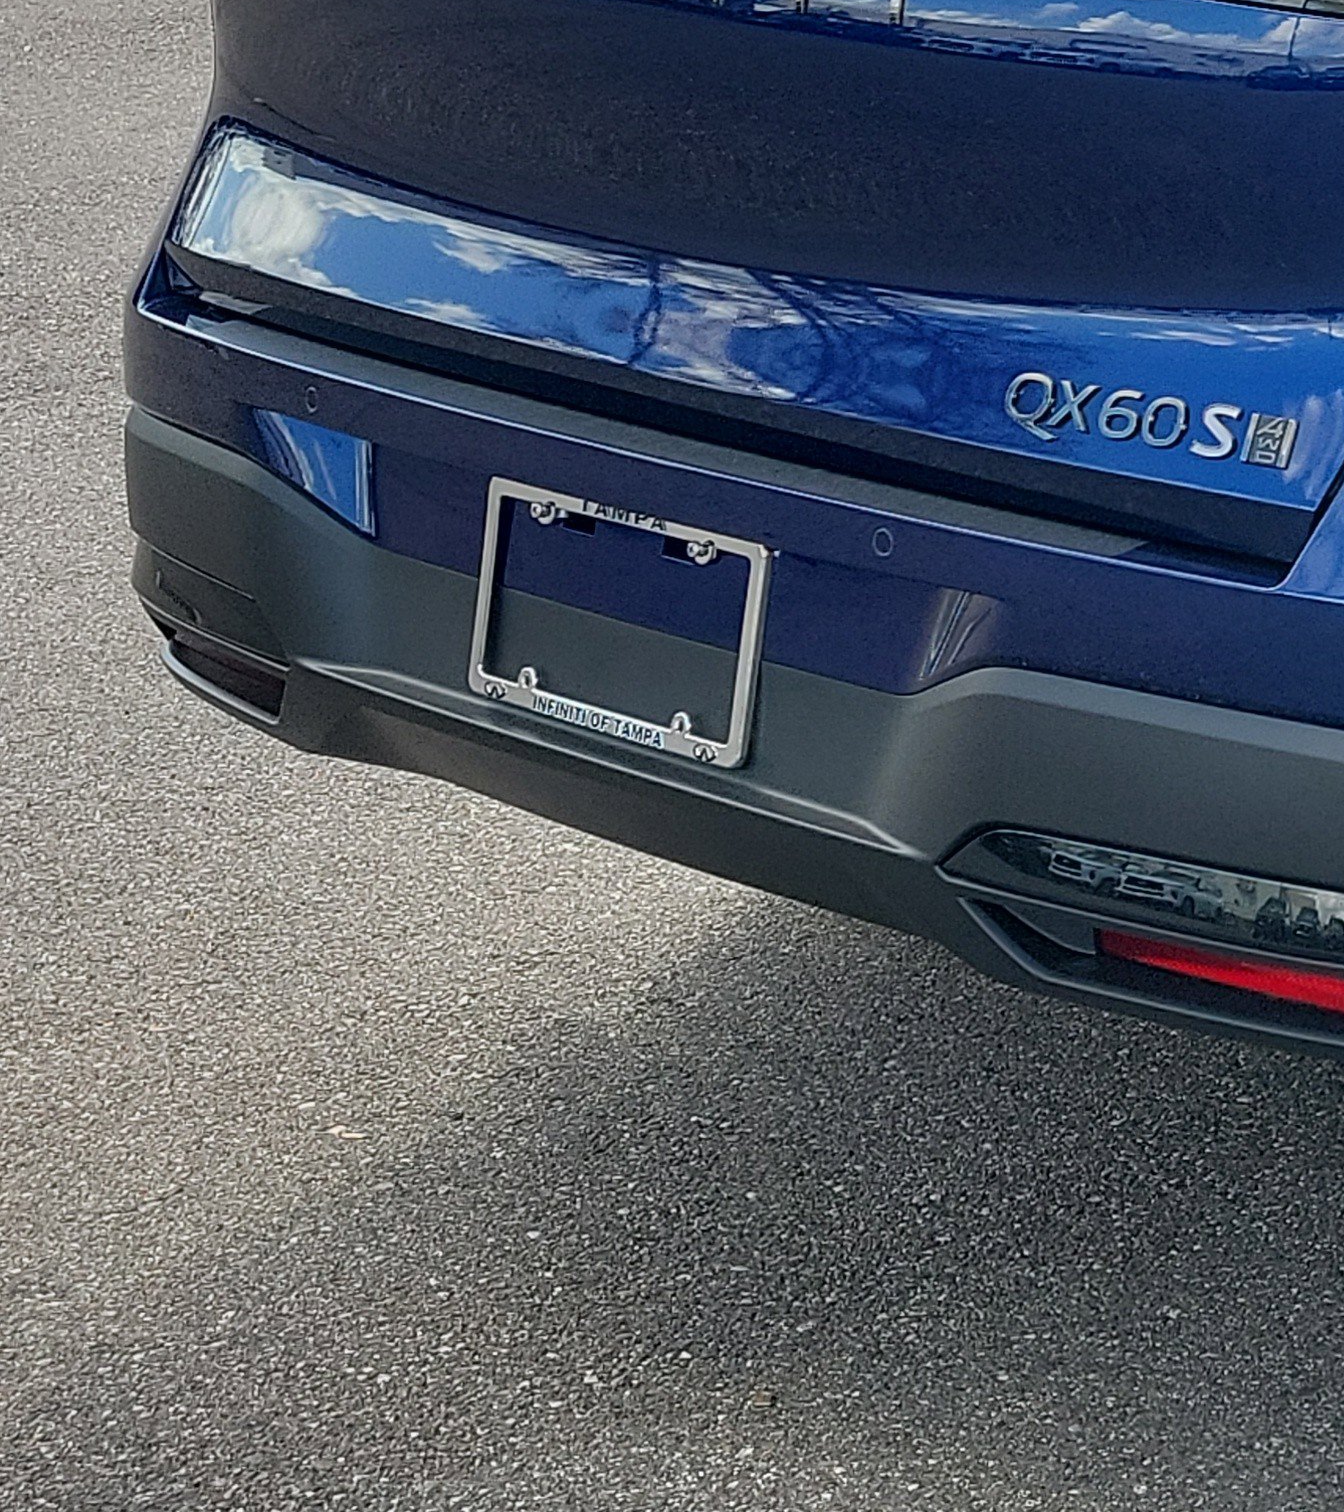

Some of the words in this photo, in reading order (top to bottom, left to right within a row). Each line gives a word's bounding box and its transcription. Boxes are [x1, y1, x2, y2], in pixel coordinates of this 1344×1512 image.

[581, 498, 667, 531] TAMPA
[532, 696, 586, 724] INFINITI
[590, 712, 610, 730] OF
[613, 718, 662, 747] TAMPA
